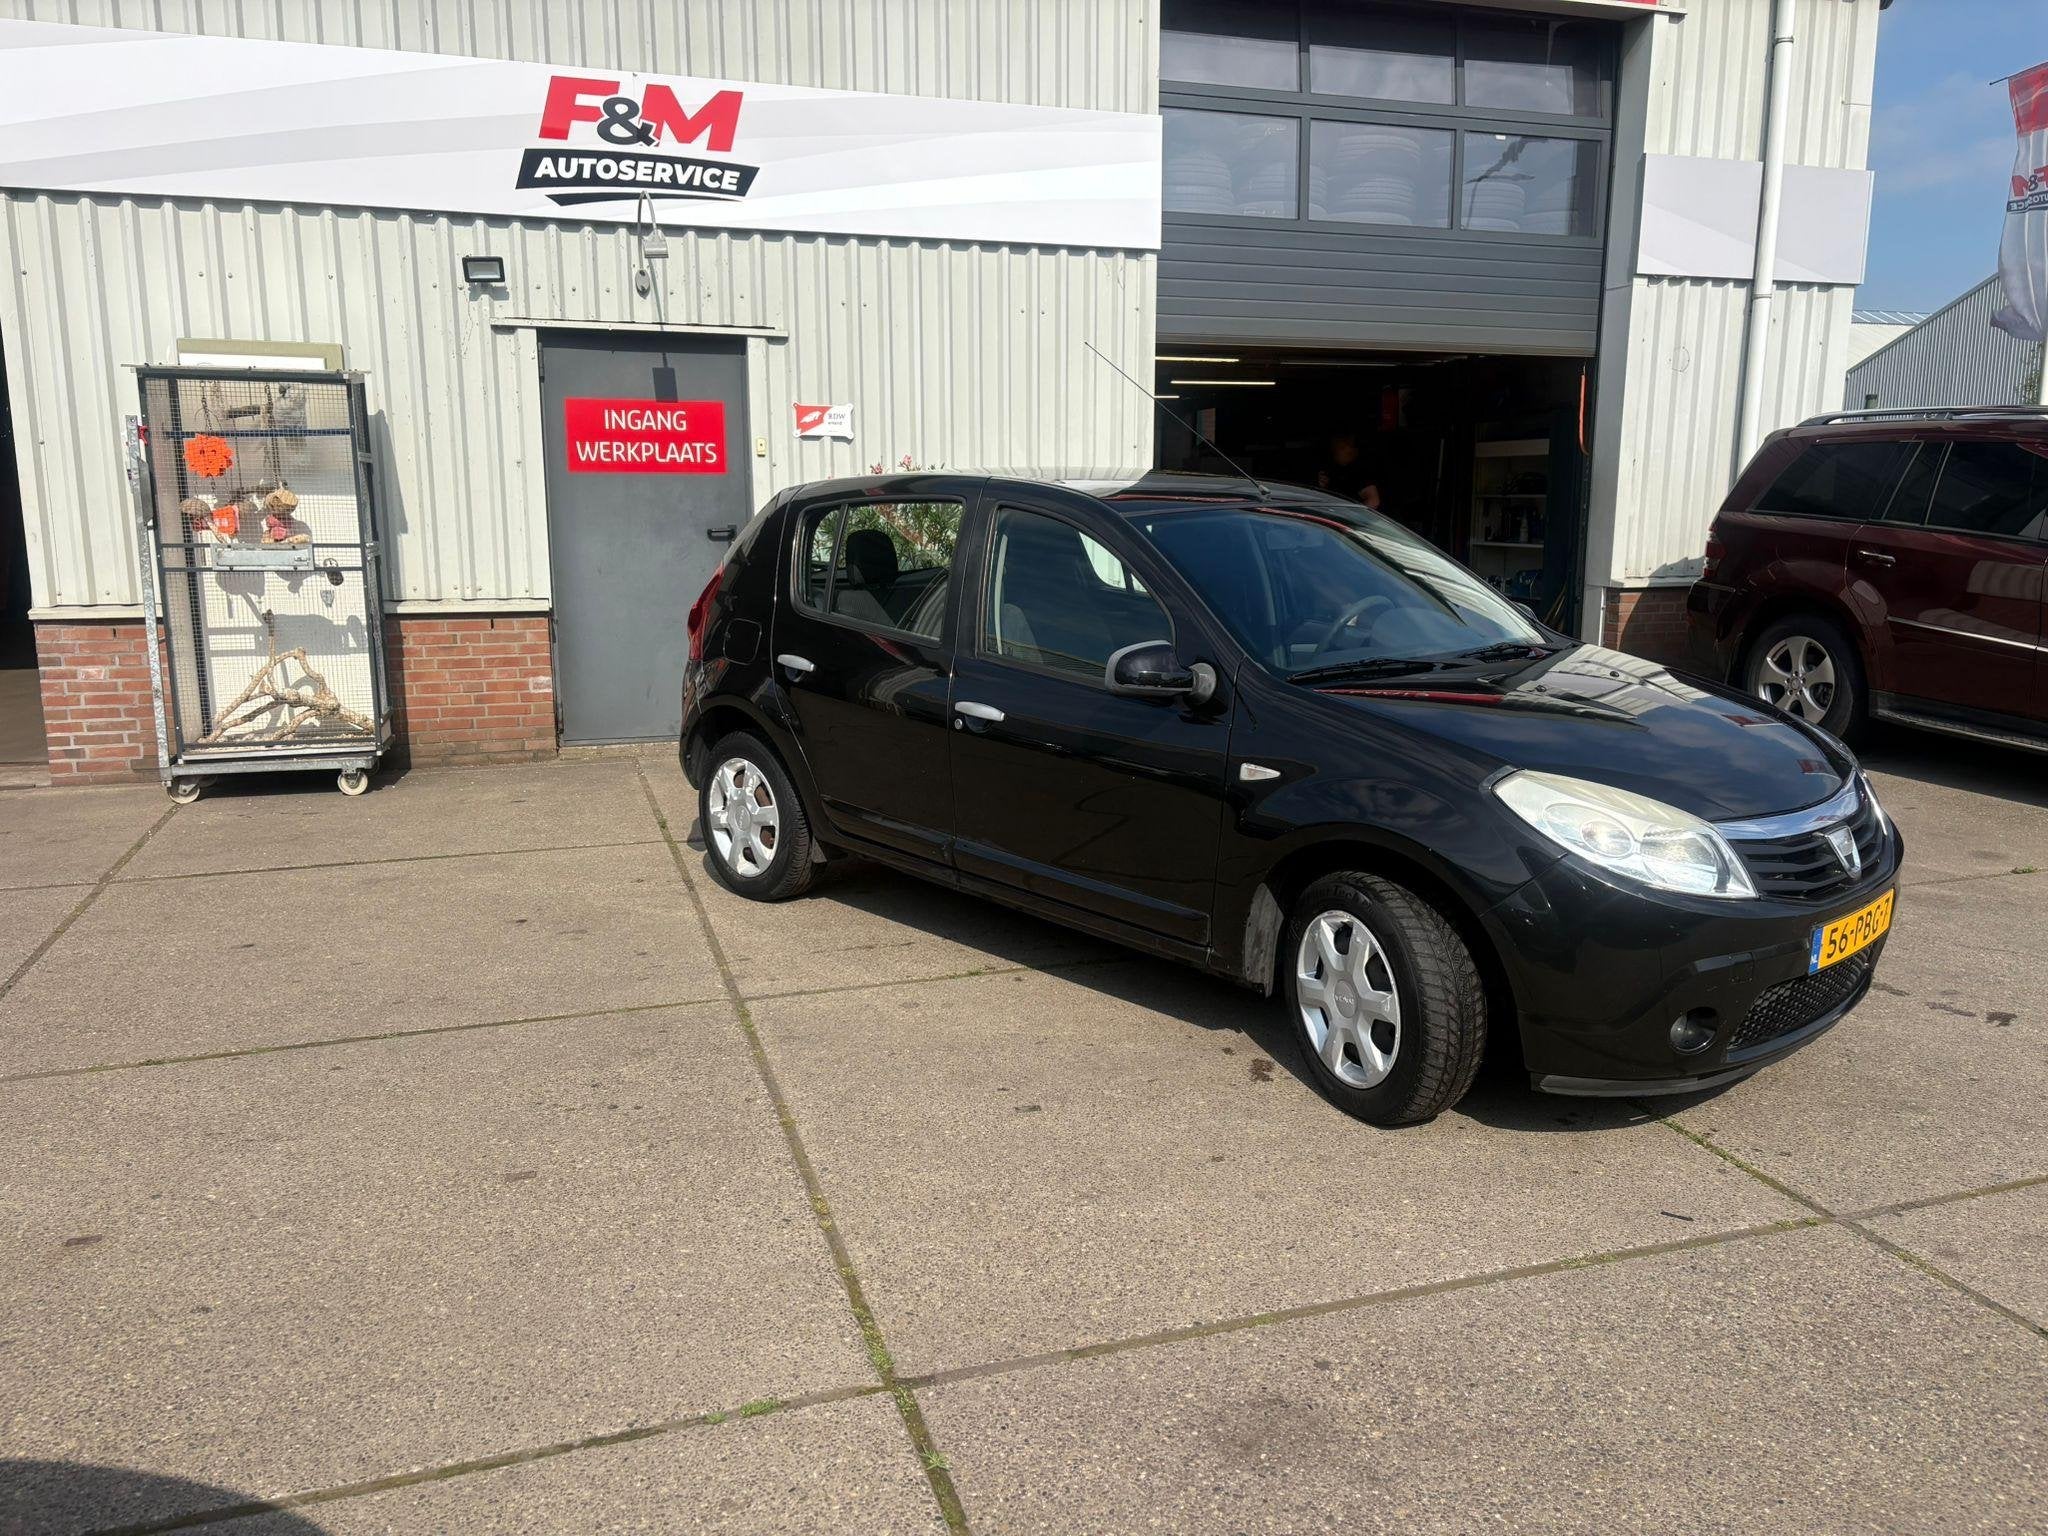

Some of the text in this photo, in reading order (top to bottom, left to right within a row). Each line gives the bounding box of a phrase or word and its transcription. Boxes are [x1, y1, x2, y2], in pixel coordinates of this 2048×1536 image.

[538, 75, 744, 152] F&M
[534, 156, 741, 190] AUTOSERVICE
[604, 409, 687, 431] INGANG
[576, 441, 717, 463] WERKPLAATS
